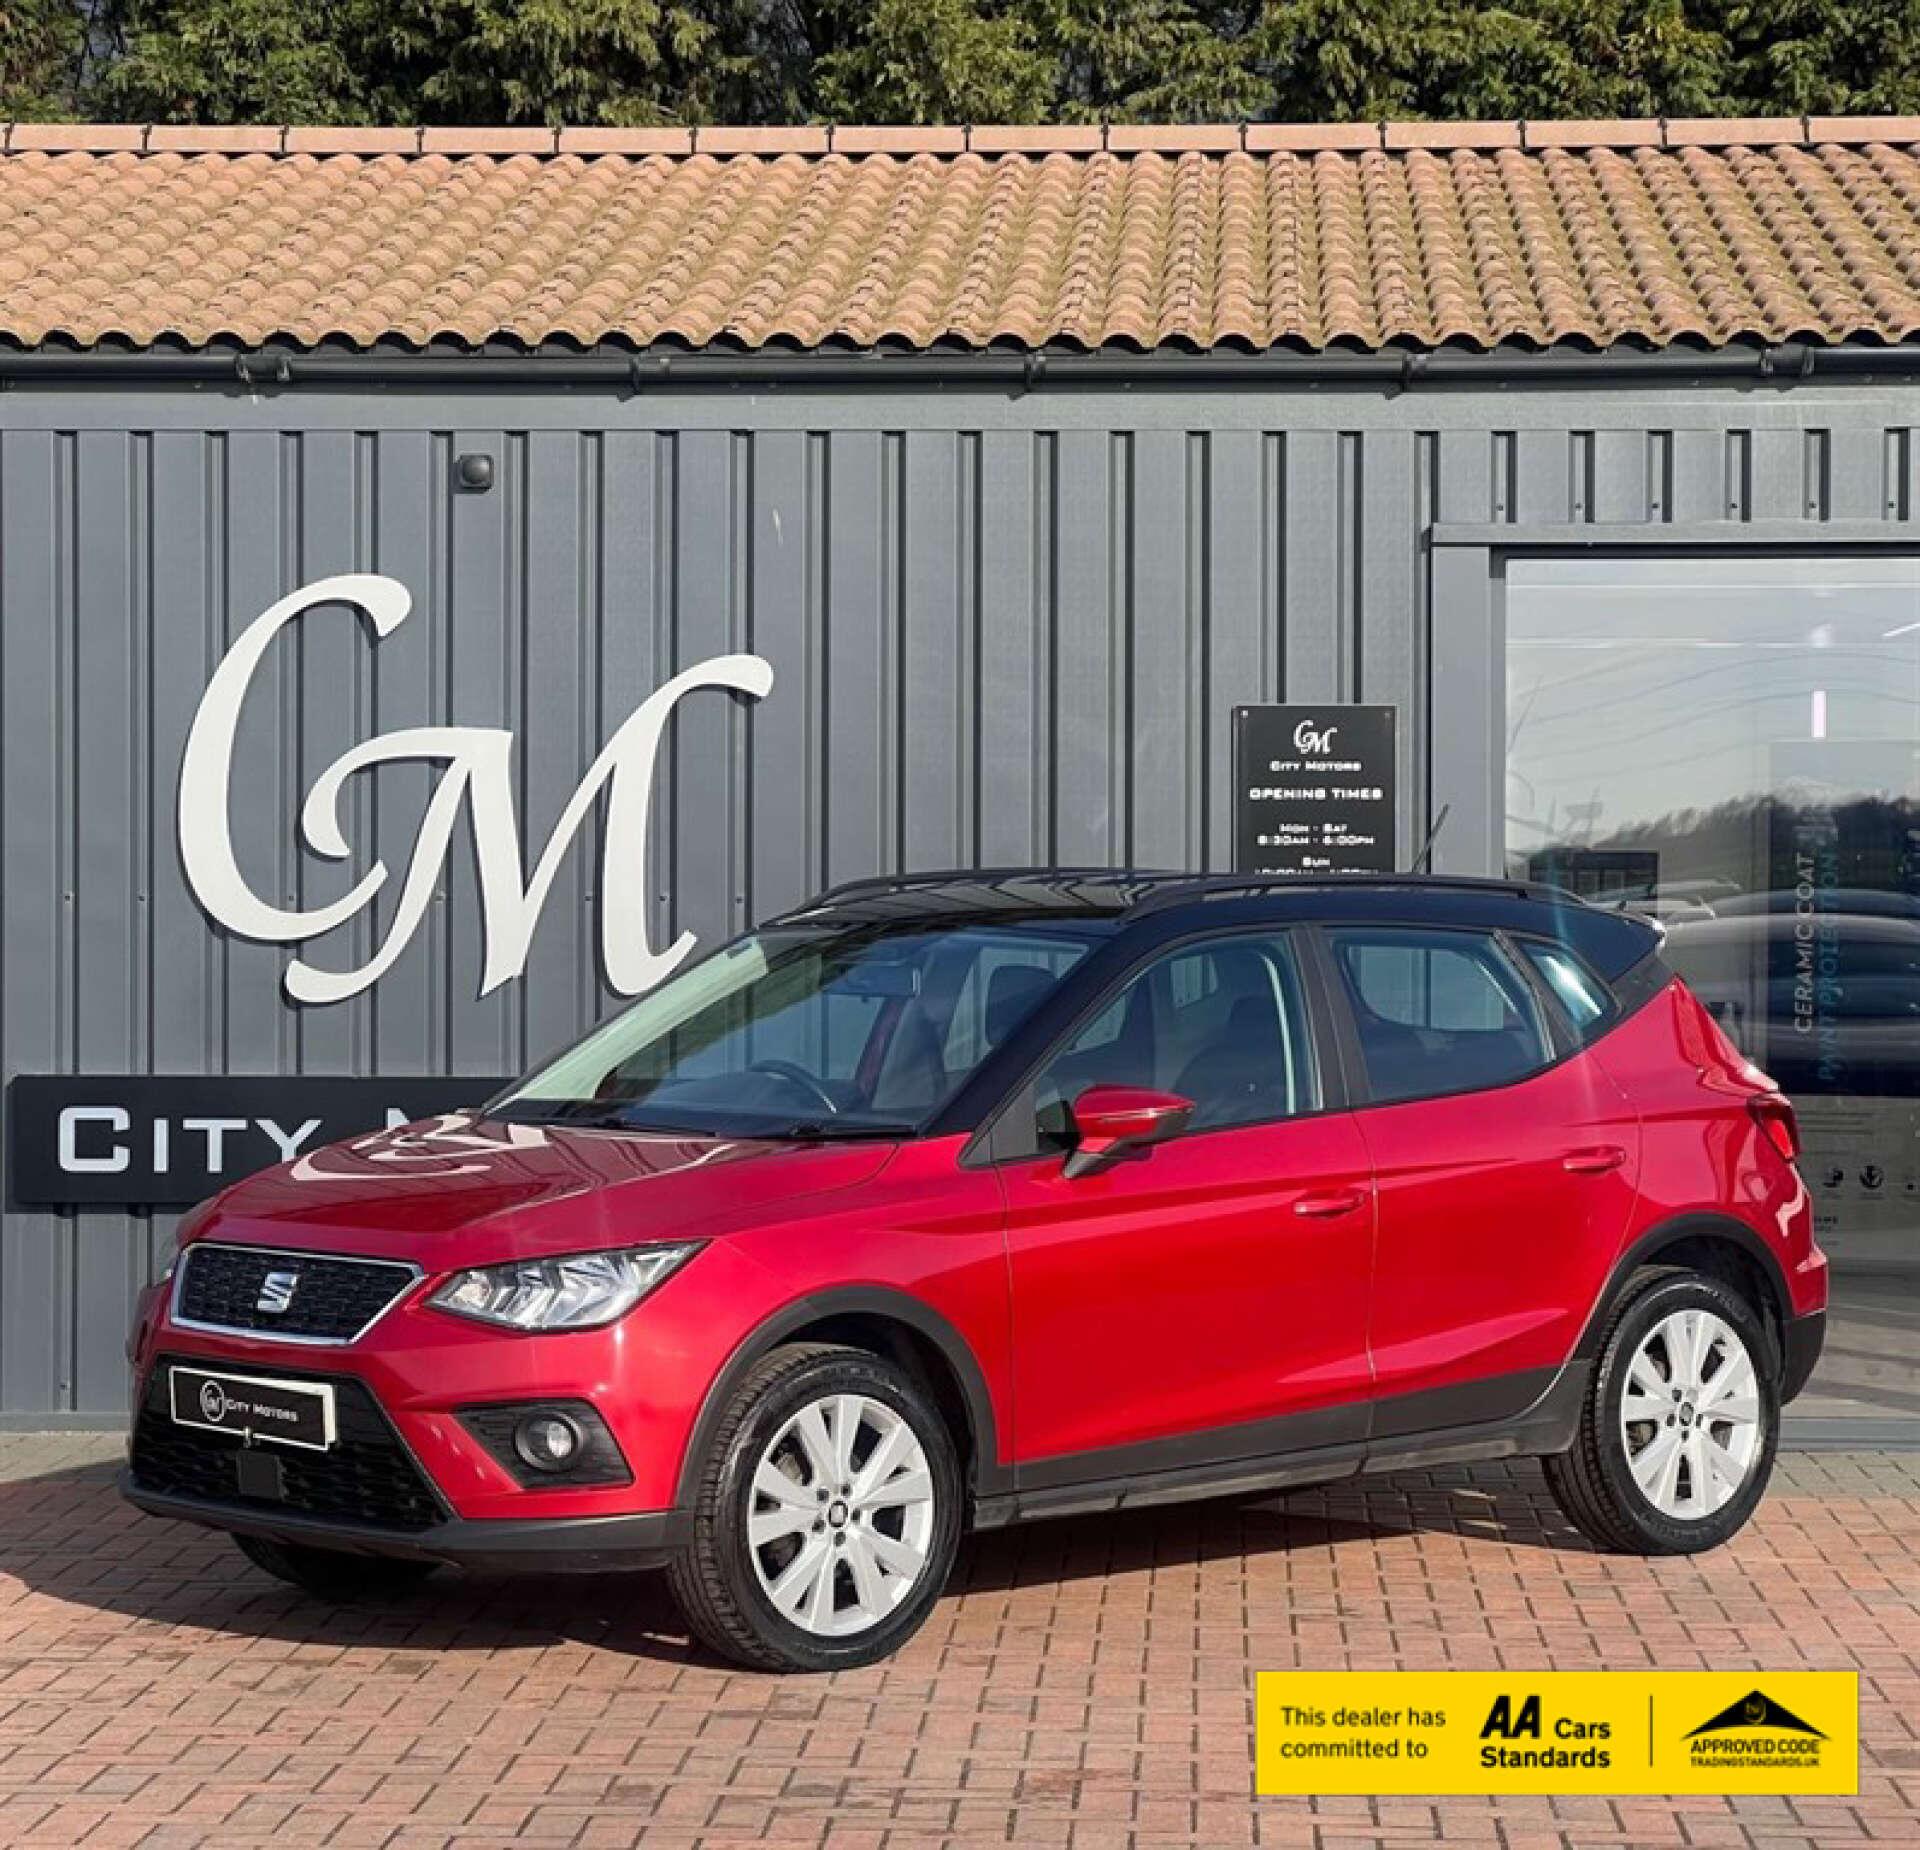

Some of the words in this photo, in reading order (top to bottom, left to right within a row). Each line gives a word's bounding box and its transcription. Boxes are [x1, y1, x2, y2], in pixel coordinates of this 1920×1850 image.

[1249, 787, 1326, 800] OPENING
[1331, 787, 1384, 800] TIMES
[1818, 853, 1840, 1006] PROTETION
[1794, 924, 1814, 1033] CERAMIC
[59, 1106, 321, 1172] CITY
